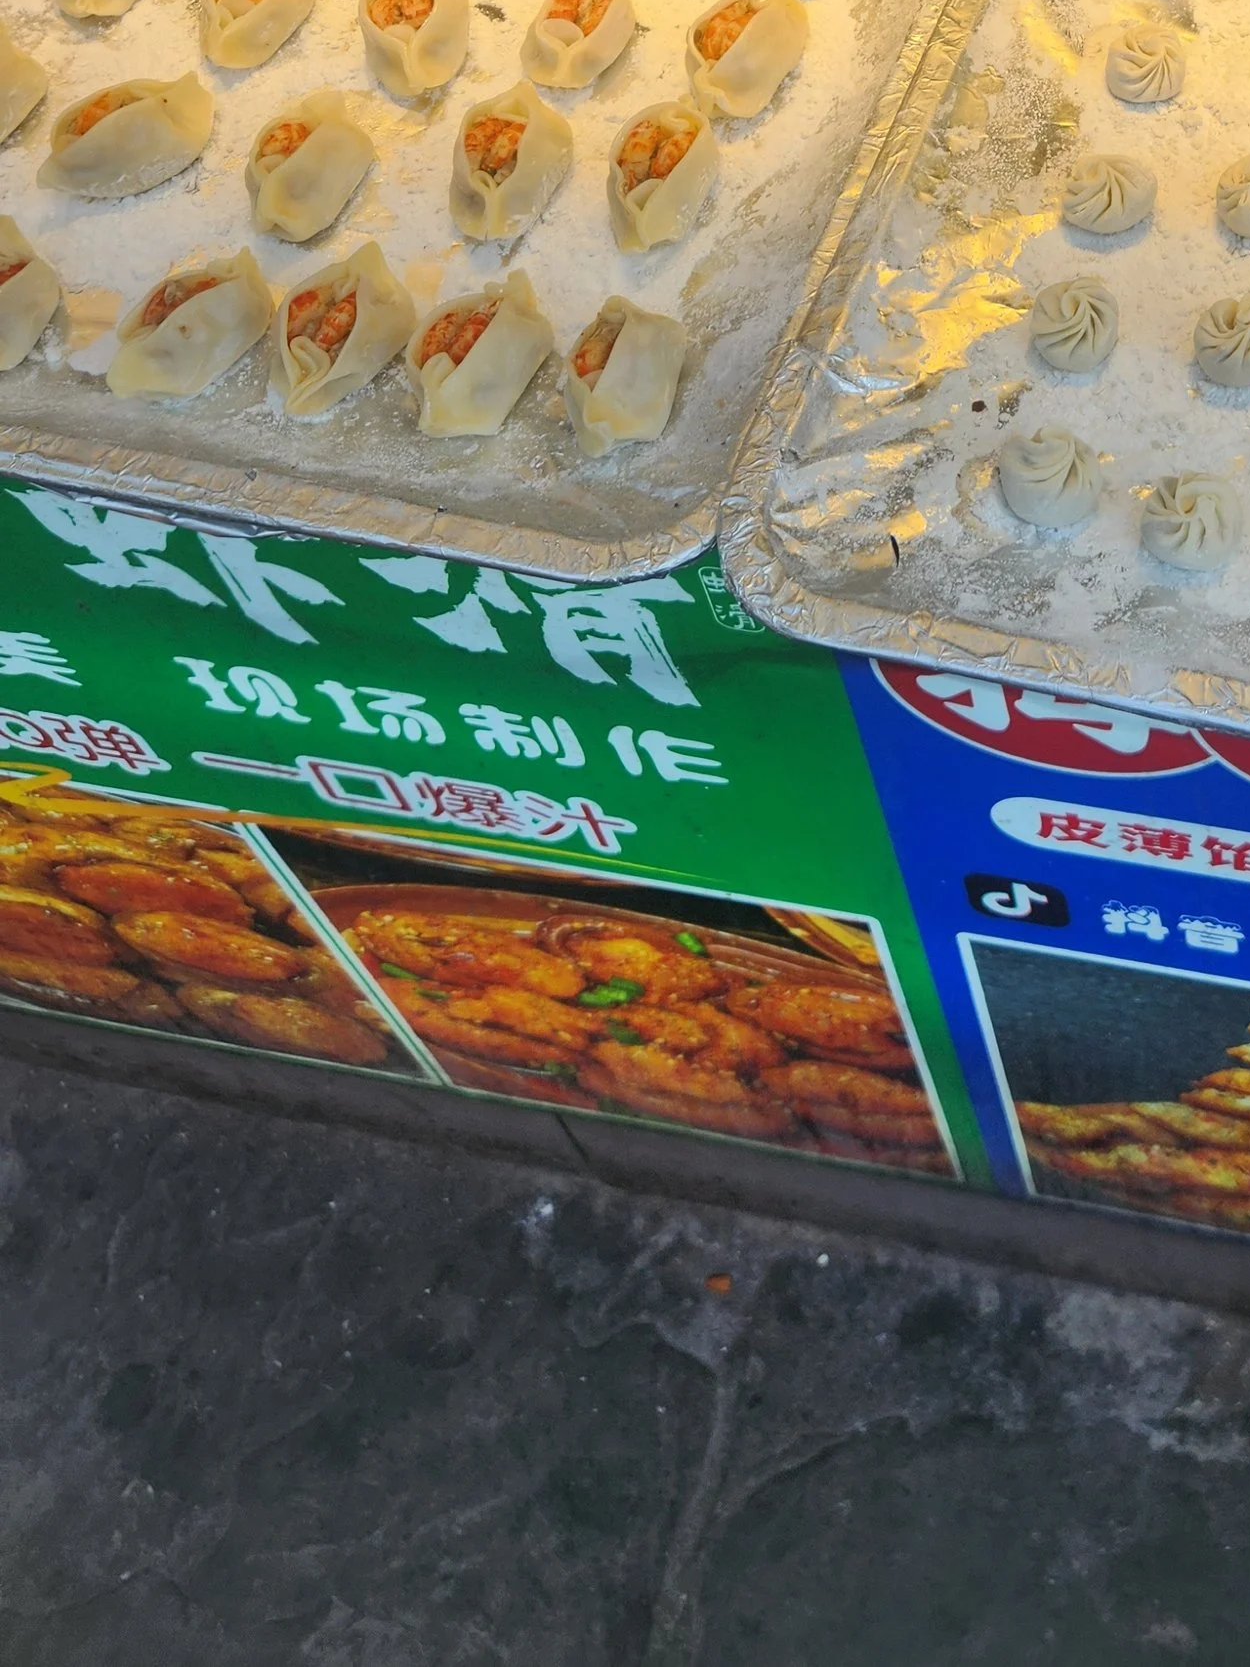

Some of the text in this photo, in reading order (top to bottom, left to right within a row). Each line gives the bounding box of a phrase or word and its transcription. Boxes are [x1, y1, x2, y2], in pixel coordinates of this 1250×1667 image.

[174, 656, 728, 784] 现场制作
[194, 750, 638, 855] 一口爆汁
[1102, 900, 1245, 955] 抖音
